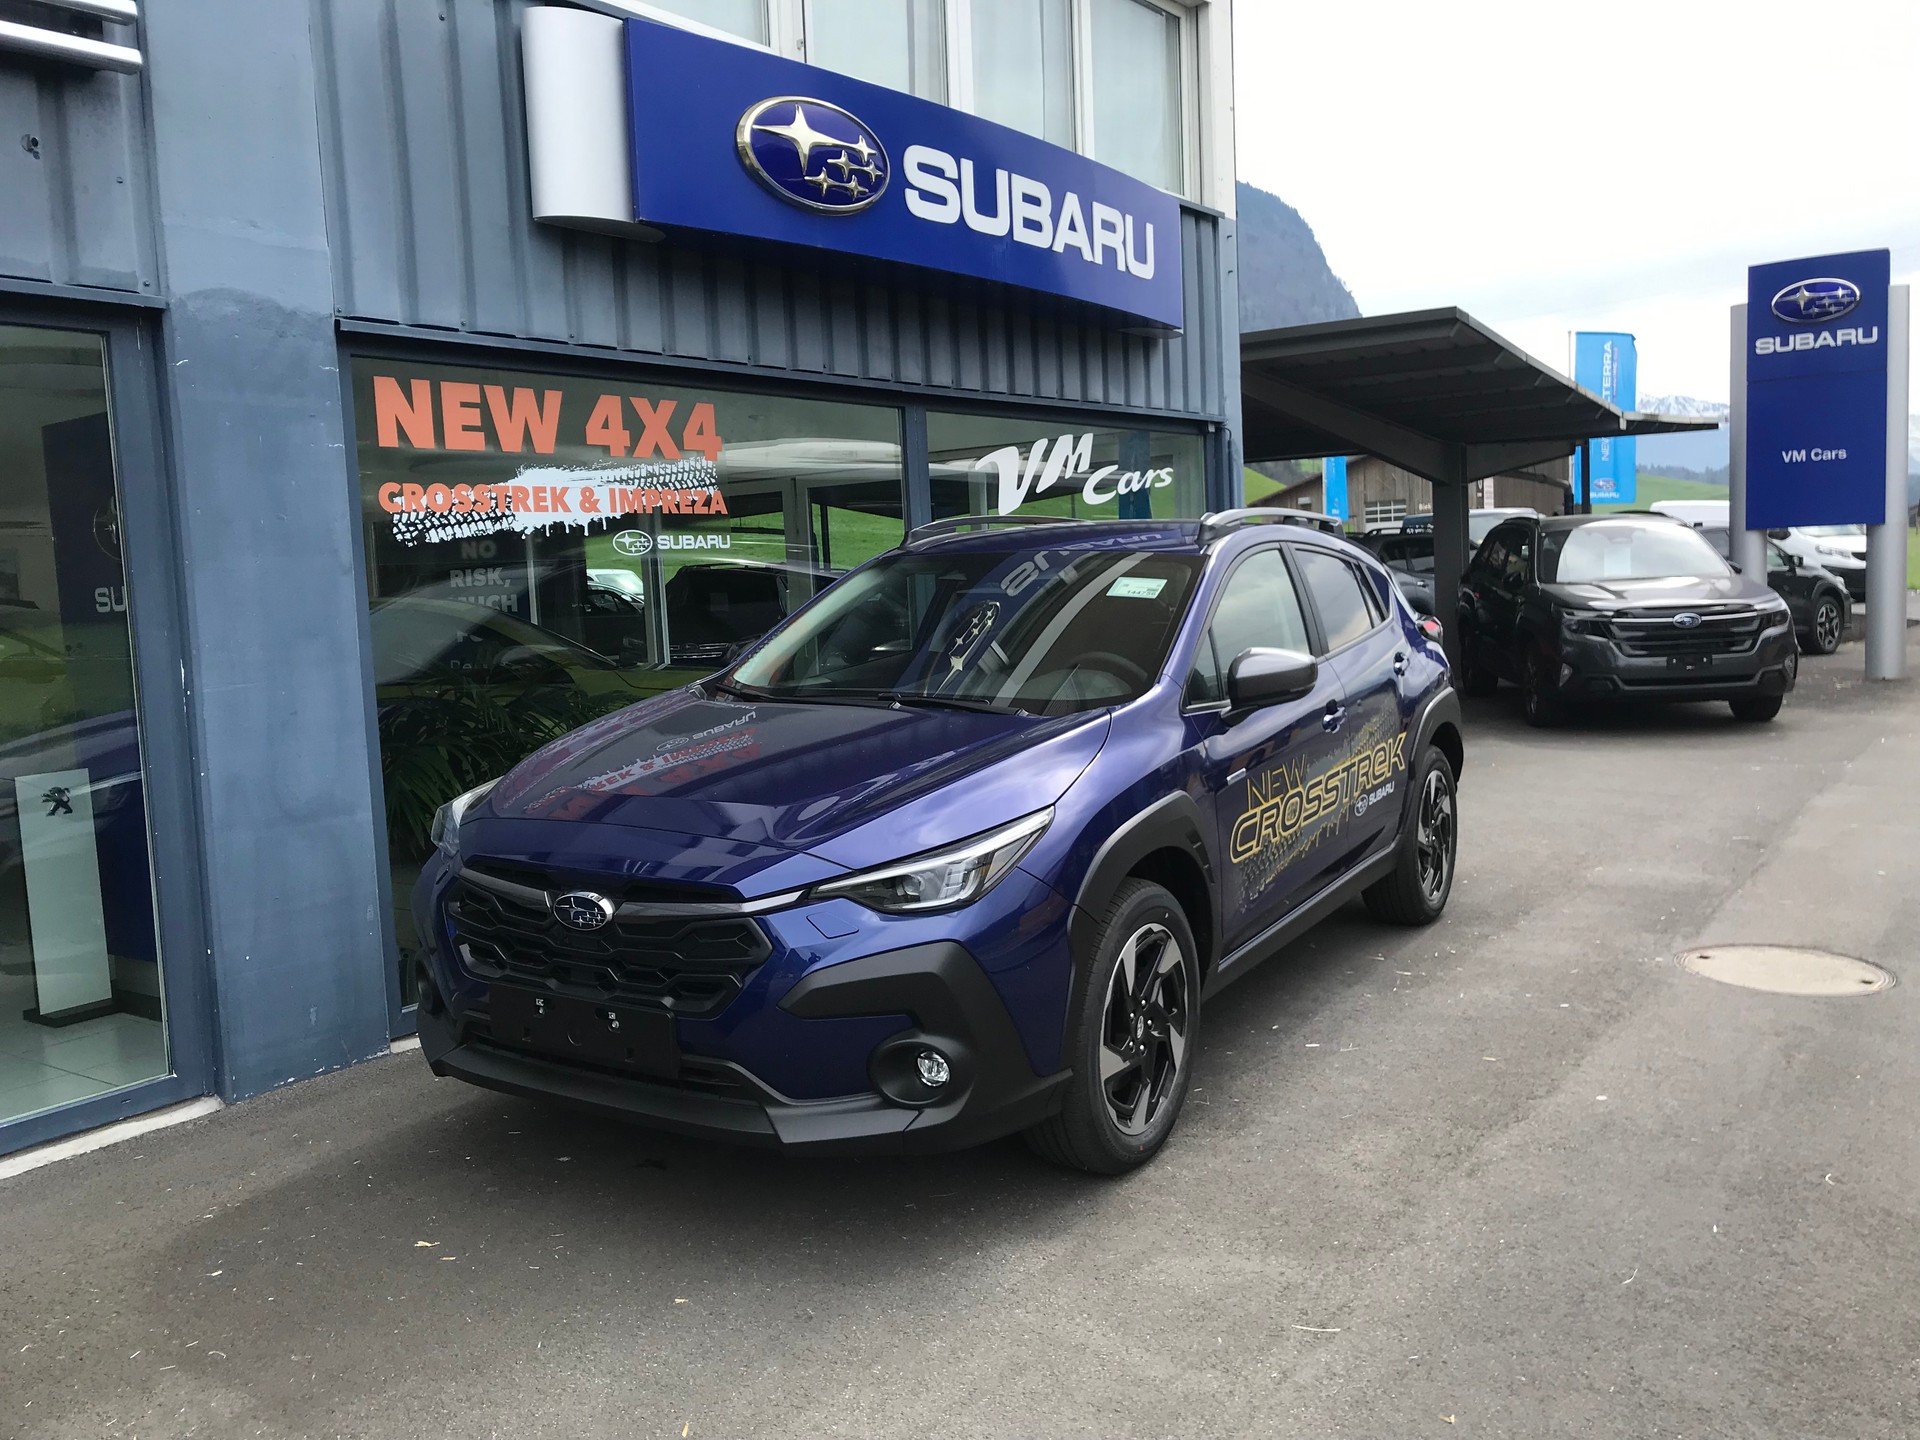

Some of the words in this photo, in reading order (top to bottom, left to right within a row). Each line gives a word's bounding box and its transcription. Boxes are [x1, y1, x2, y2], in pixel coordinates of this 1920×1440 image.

[903, 145, 1154, 280] SUBARU
[1755, 326, 1878, 355] SUBARU
[373, 375, 562, 454] NEW
[585, 394, 723, 462] 4X4
[1782, 449, 1806, 464] VM
[1811, 448, 1847, 461] Cars
[974, 432, 1094, 516] VM
[1082, 464, 1174, 505] Cars
[378, 482, 571, 513] CROSSTREK
[579, 489, 602, 513] &
[609, 487, 728, 515] IMPREZA
[460, 539, 497, 560] NO
[657, 534, 730, 549] SUBARU
[449, 567, 512, 588] RISK,
[449, 593, 518, 612] UCH
[1247, 753, 1307, 812] NEW
[1369, 782, 1394, 805] SUBARU
